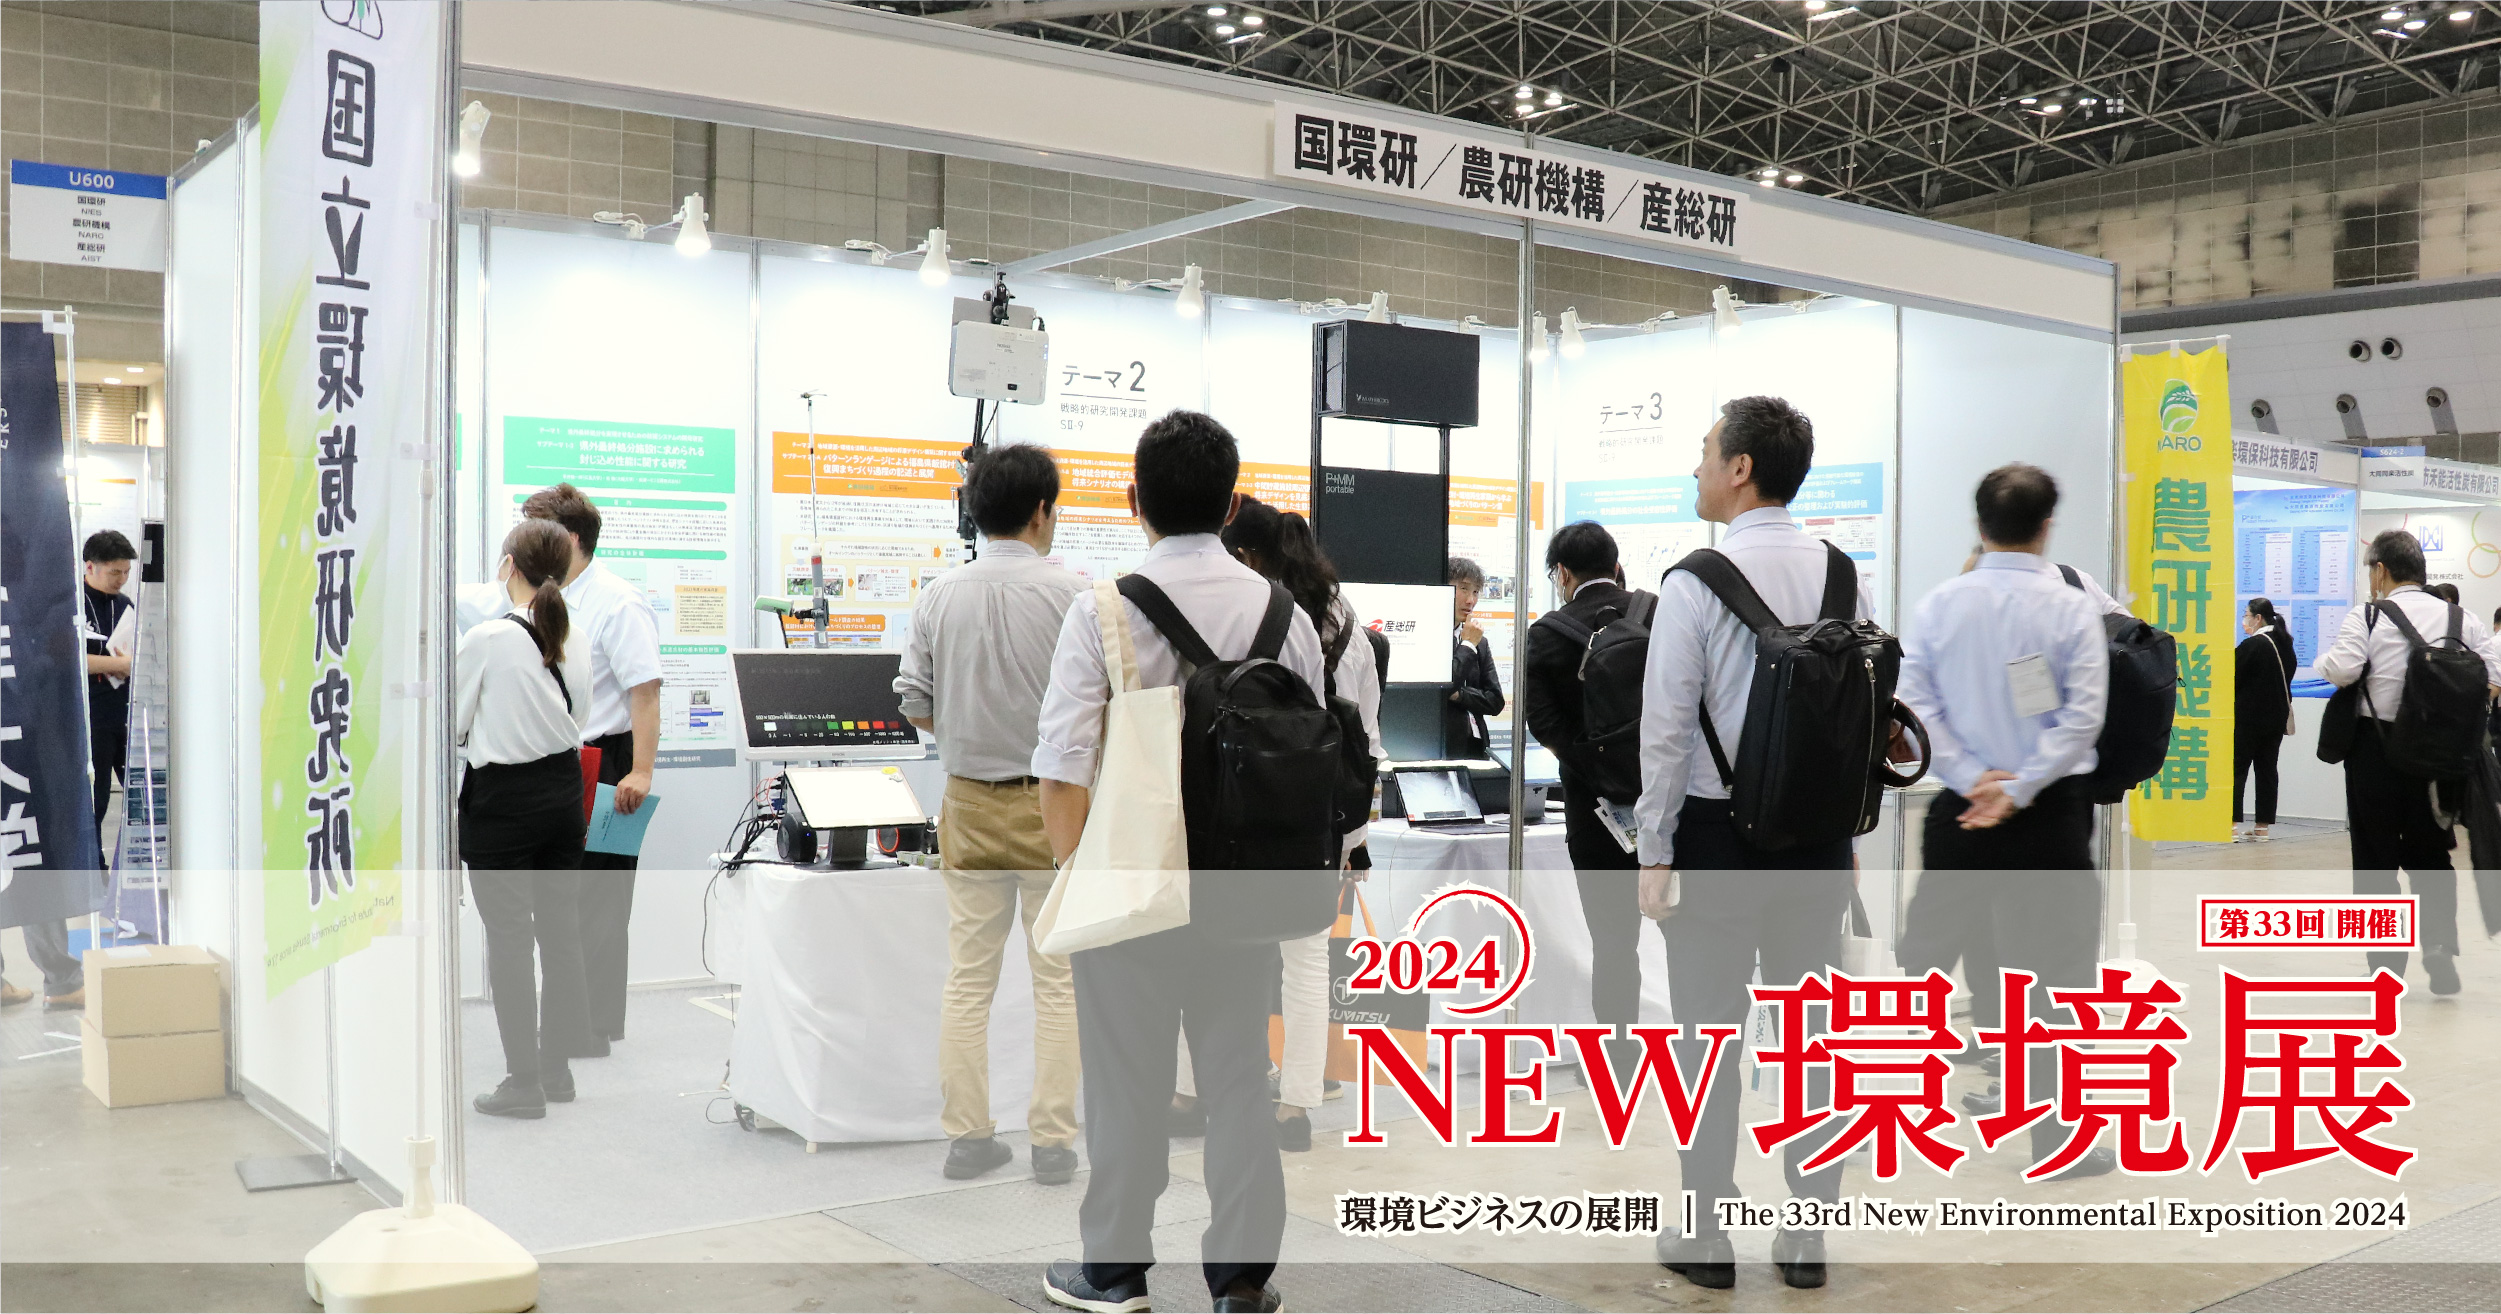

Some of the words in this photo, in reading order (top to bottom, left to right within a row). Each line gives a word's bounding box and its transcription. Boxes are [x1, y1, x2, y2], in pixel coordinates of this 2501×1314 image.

[69, 171, 115, 189] U600
[1061, 365, 1122, 389] テーマ
[1129, 360, 1146, 392] 2
[1060, 402, 1147, 419] 戦略的研究開発課題
[1600, 405, 1644, 425] テーマ
[1650, 392, 1663, 420] 3
[579, 454, 687, 470] 封じ込め性能に関する研究
[1325, 485, 1355, 495] portable
